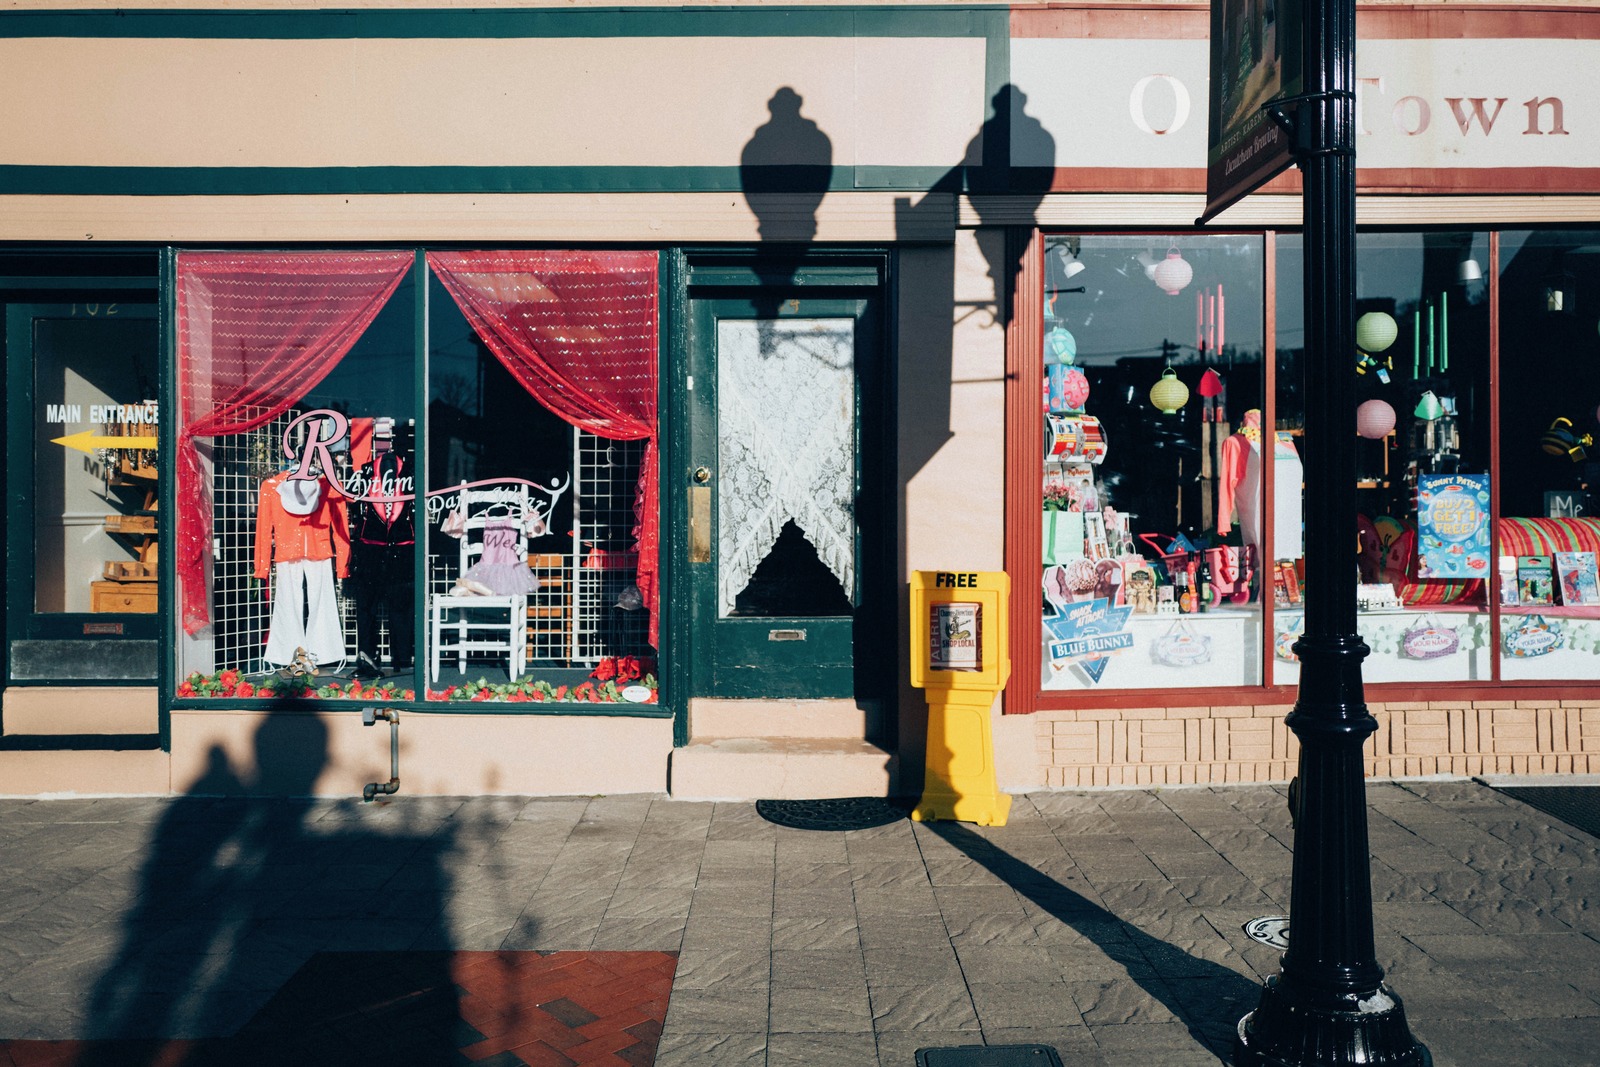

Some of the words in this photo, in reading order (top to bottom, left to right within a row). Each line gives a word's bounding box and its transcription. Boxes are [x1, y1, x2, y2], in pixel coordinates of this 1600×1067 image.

[1242, 112, 1262, 136] KAREN
[1254, 126, 1279, 154] Brewing
[46, 404, 81, 423] MAIN
[1456, 475, 1482, 491] PATCH
[1435, 498, 1463, 509] BUY
[1464, 499, 1475, 509] 2
[1433, 510, 1464, 522] GET
[1468, 510, 1475, 522] 1
[1435, 522, 1475, 535] FREE!
[936, 573, 978, 588] FREE
[1075, 608, 1105, 629] ATTACK!
[931, 607, 940, 661] APRIL
[1432, 638, 1450, 646] NAME
[942, 639, 957, 648] SHOP
[958, 639, 975, 648] LOCAL
[1055, 641, 1086, 657] BLUE
